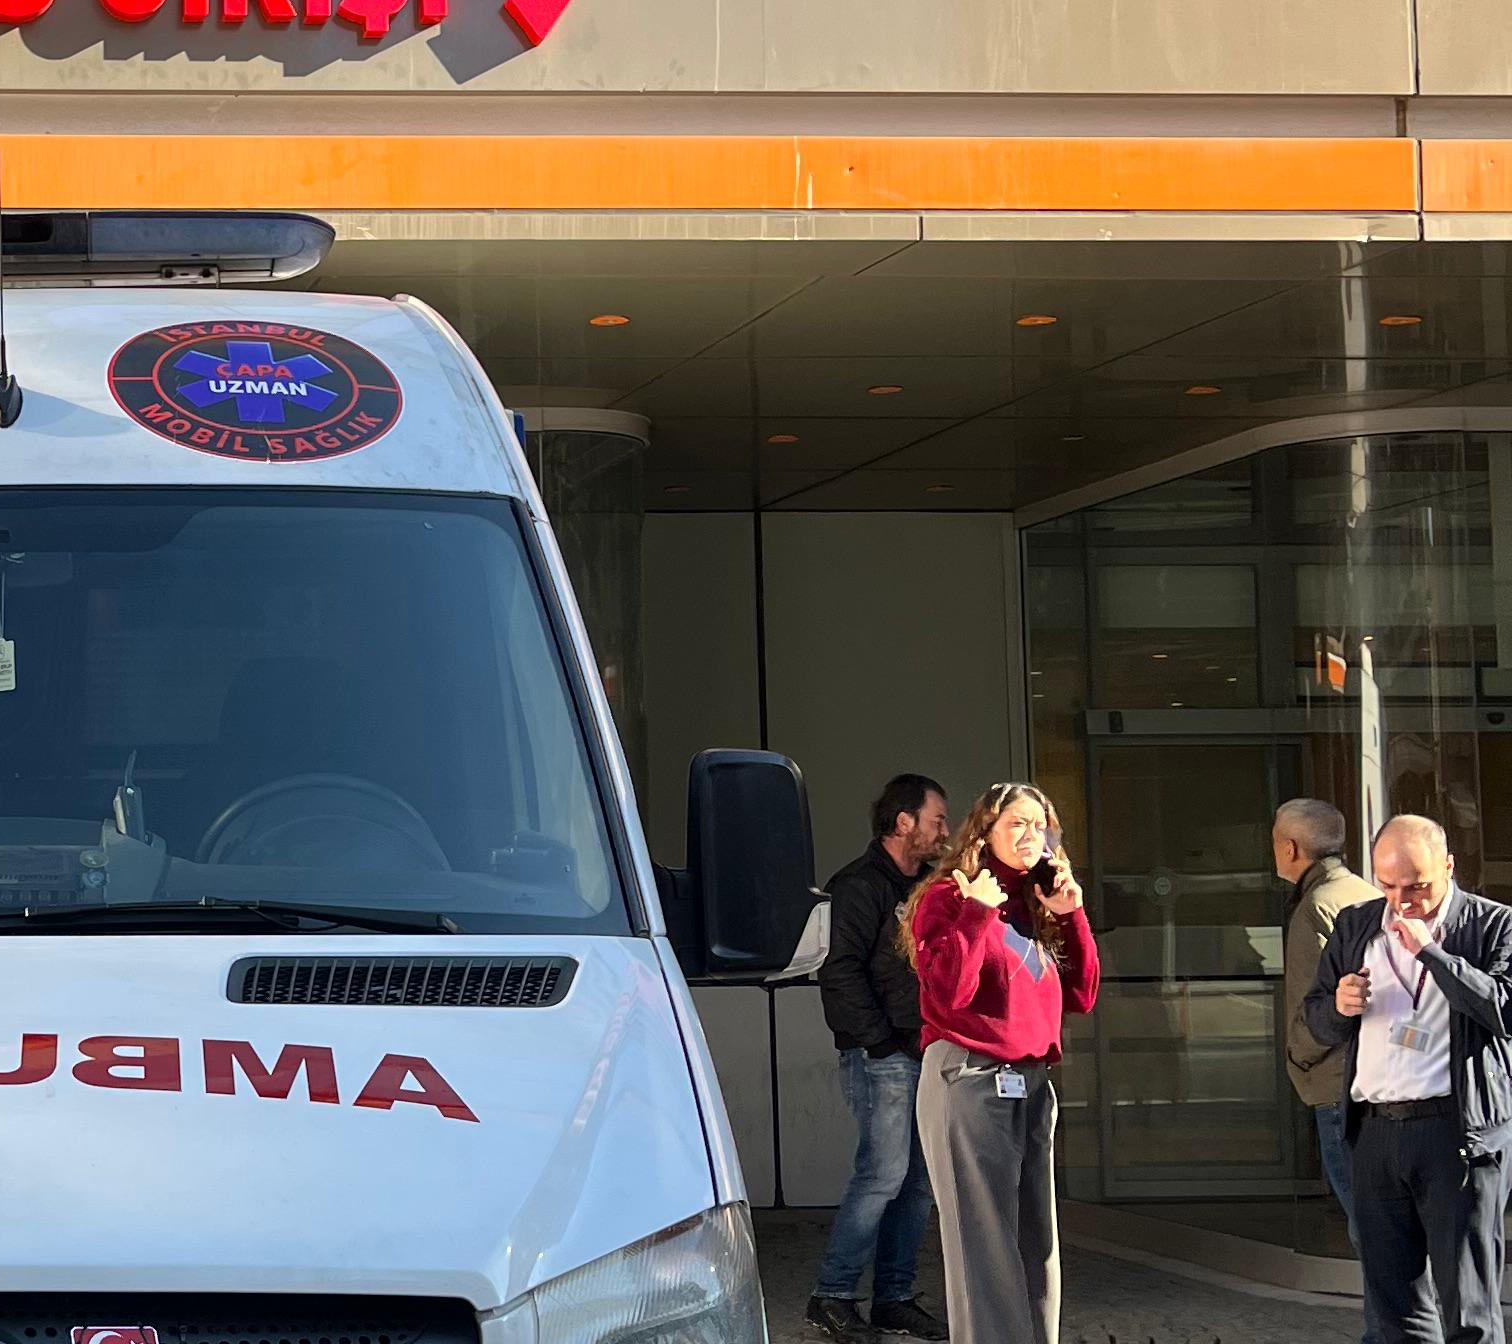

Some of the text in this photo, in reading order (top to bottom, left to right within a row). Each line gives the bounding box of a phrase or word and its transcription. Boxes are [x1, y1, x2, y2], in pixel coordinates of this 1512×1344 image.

[153, 322, 326, 346] İSTANBUL
[216, 363, 293, 379] ÇAPA
[209, 380, 308, 396] UZMAN
[139, 403, 383, 454] MOBİL SAĞLIK
